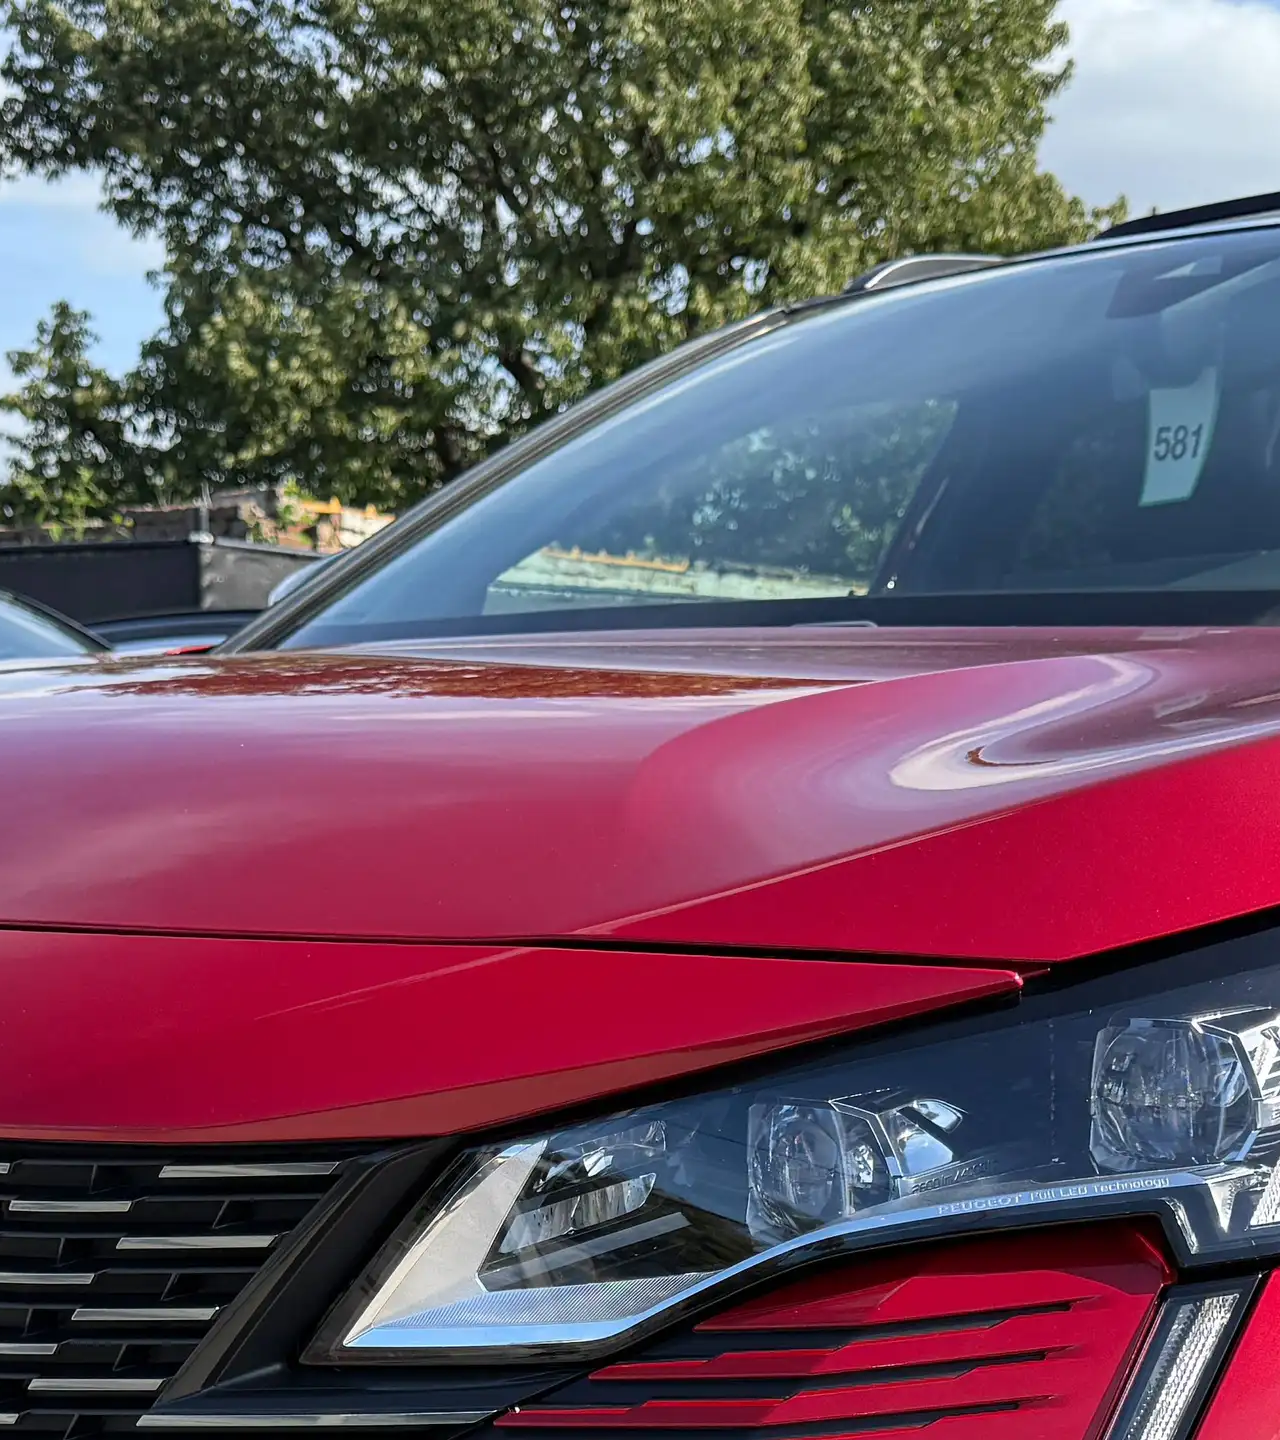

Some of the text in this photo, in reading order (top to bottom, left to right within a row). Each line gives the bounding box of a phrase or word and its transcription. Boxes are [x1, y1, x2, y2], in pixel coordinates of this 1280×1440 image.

[1153, 423, 1203, 461] 581
[937, 1193, 1023, 1215] PEUGEOT
[1060, 1185, 1089, 1198] LED
[1092, 1177, 1171, 1195] Technology
